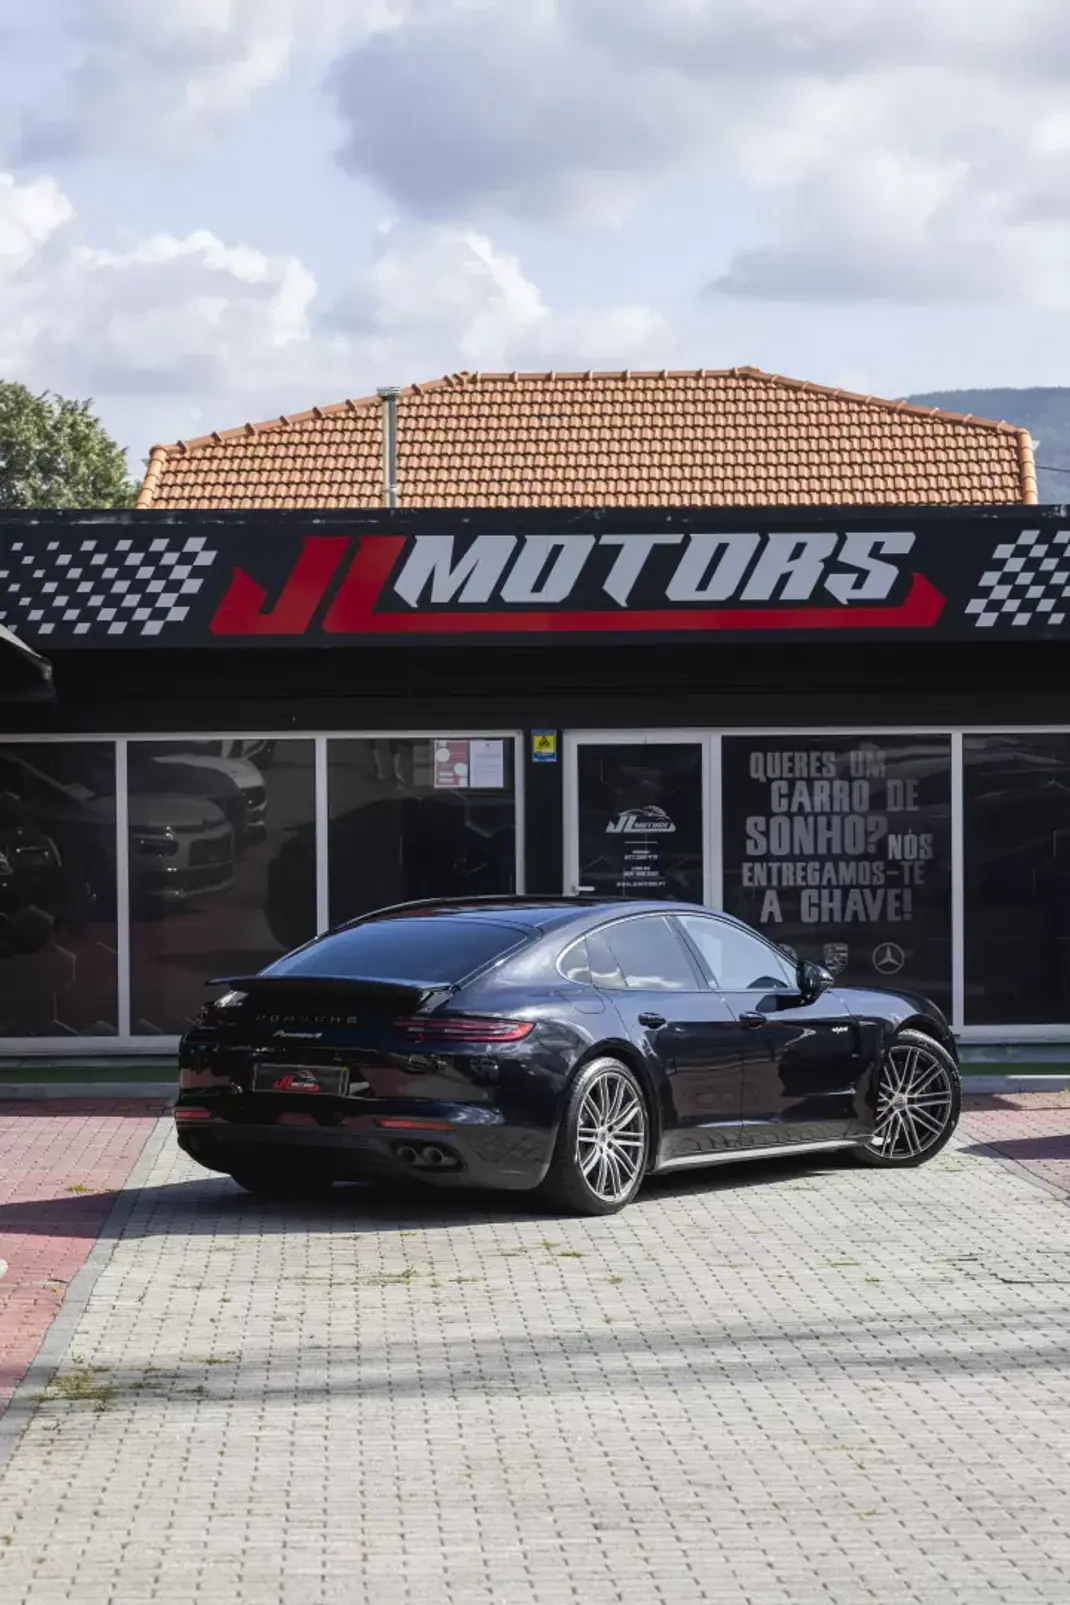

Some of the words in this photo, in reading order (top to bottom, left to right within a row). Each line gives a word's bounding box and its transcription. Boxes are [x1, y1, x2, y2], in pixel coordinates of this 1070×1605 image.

[393, 531, 916, 608] MOTORS
[749, 751, 837, 783] QUERES
[850, 750, 886, 779] UM
[771, 780, 870, 813] CARRO
[886, 779, 920, 812] DE
[745, 815, 888, 856] SONHO?
[888, 829, 934, 861] NÓS
[742, 860, 926, 887] ENTREGAMOS-TE
[759, 888, 783, 923] A
[800, 888, 913, 923] CHAVE!
